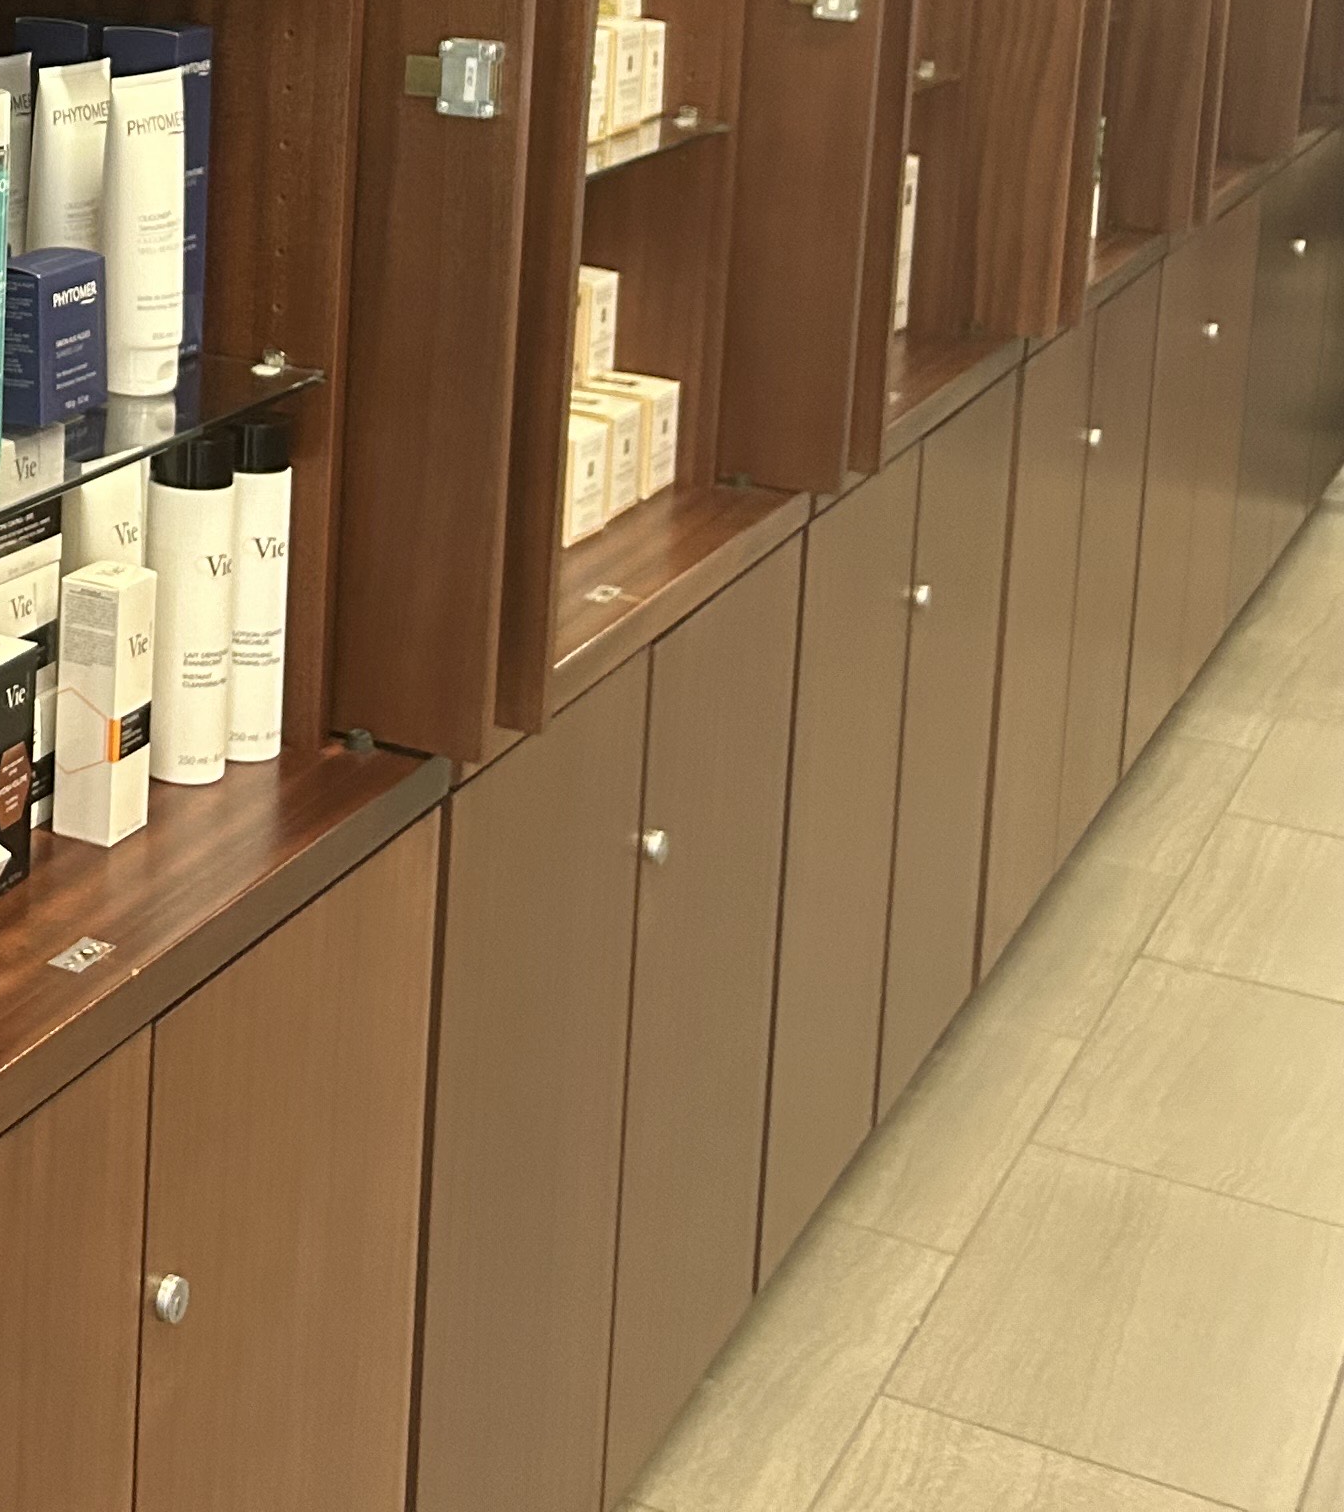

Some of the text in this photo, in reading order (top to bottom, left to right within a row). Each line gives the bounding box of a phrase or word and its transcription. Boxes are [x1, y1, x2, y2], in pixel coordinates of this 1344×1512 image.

[53, 280, 97, 308] PHYTOMER
[14, 455, 38, 481] Vie
[115, 521, 139, 546] Vie
[254, 537, 286, 559] Vie
[11, 594, 33, 620] Vie
[128, 633, 149, 658] Vie
[6, 685, 27, 709] Vie
